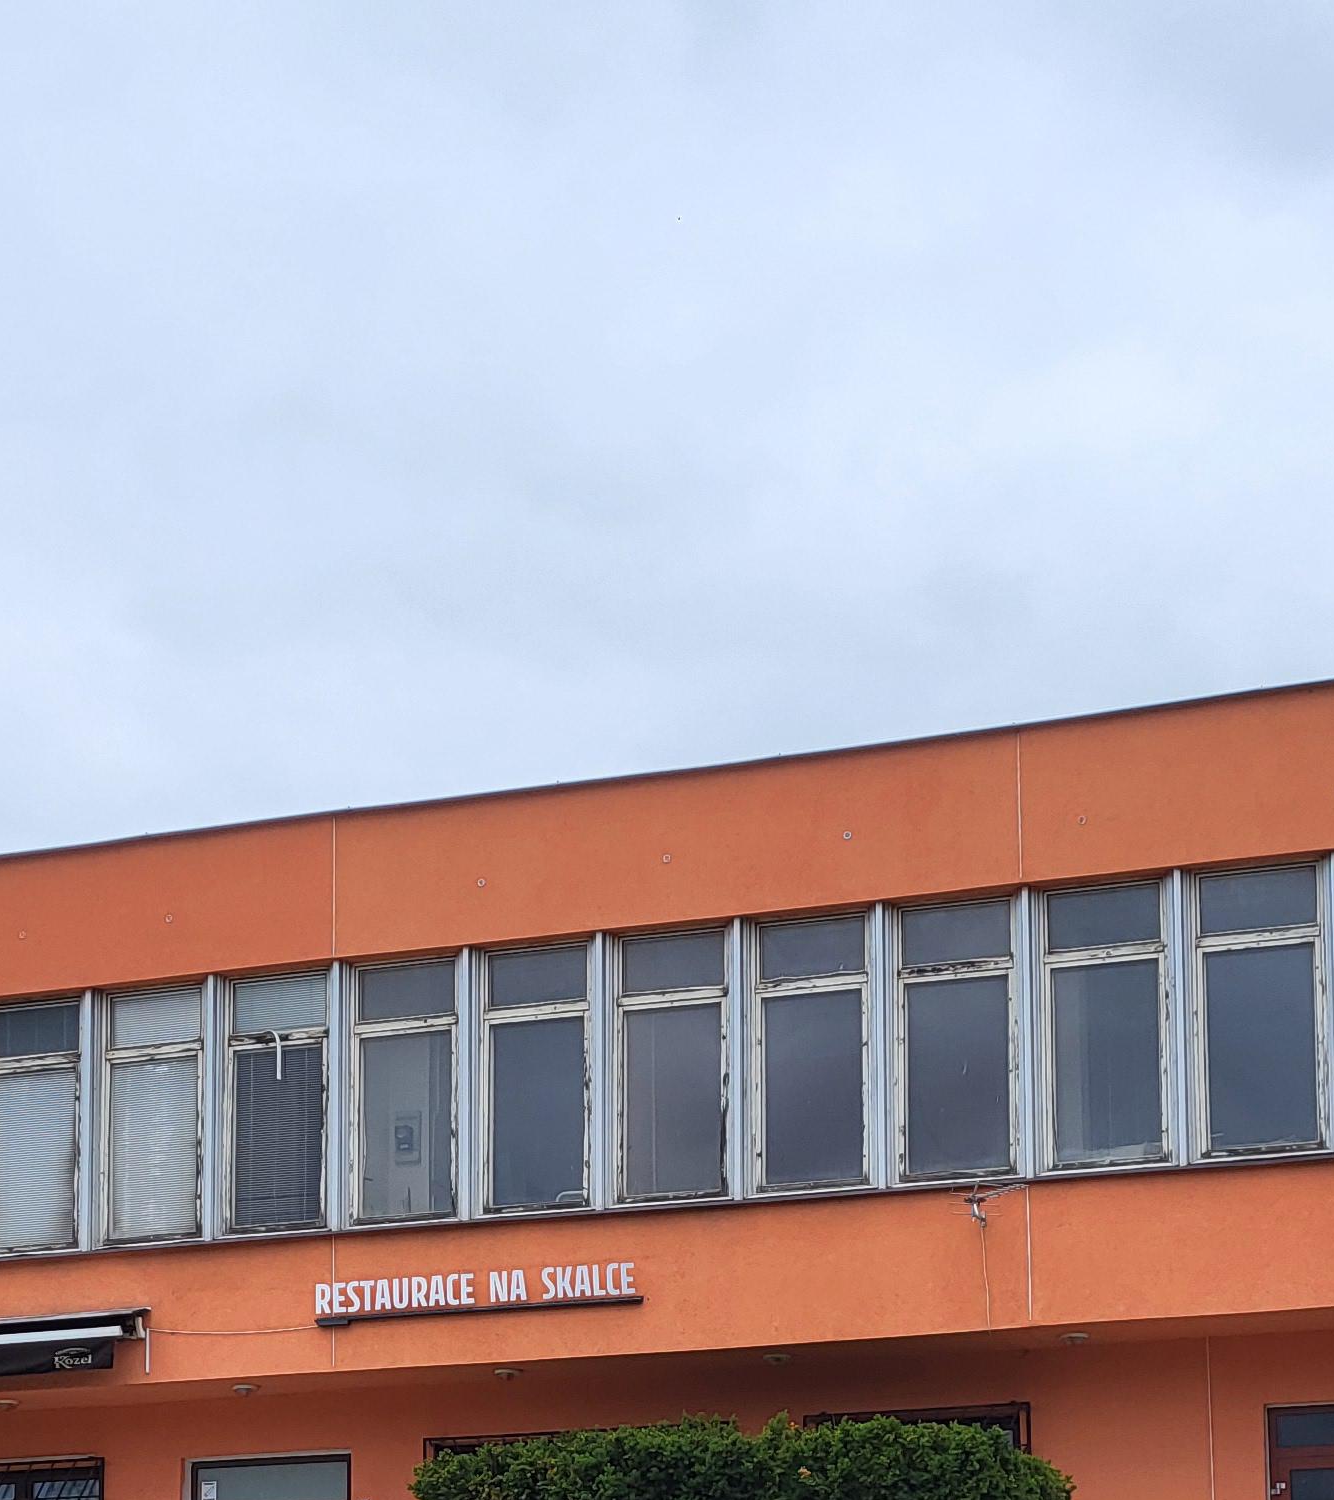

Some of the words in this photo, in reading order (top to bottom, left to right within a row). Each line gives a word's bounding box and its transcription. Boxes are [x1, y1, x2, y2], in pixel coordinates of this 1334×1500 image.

[314, 1272, 476, 1315] RESTAURACE
[489, 1269, 528, 1303] NA
[541, 1262, 636, 1300] SKALCE
[53, 1354, 92, 1369] Kozel
